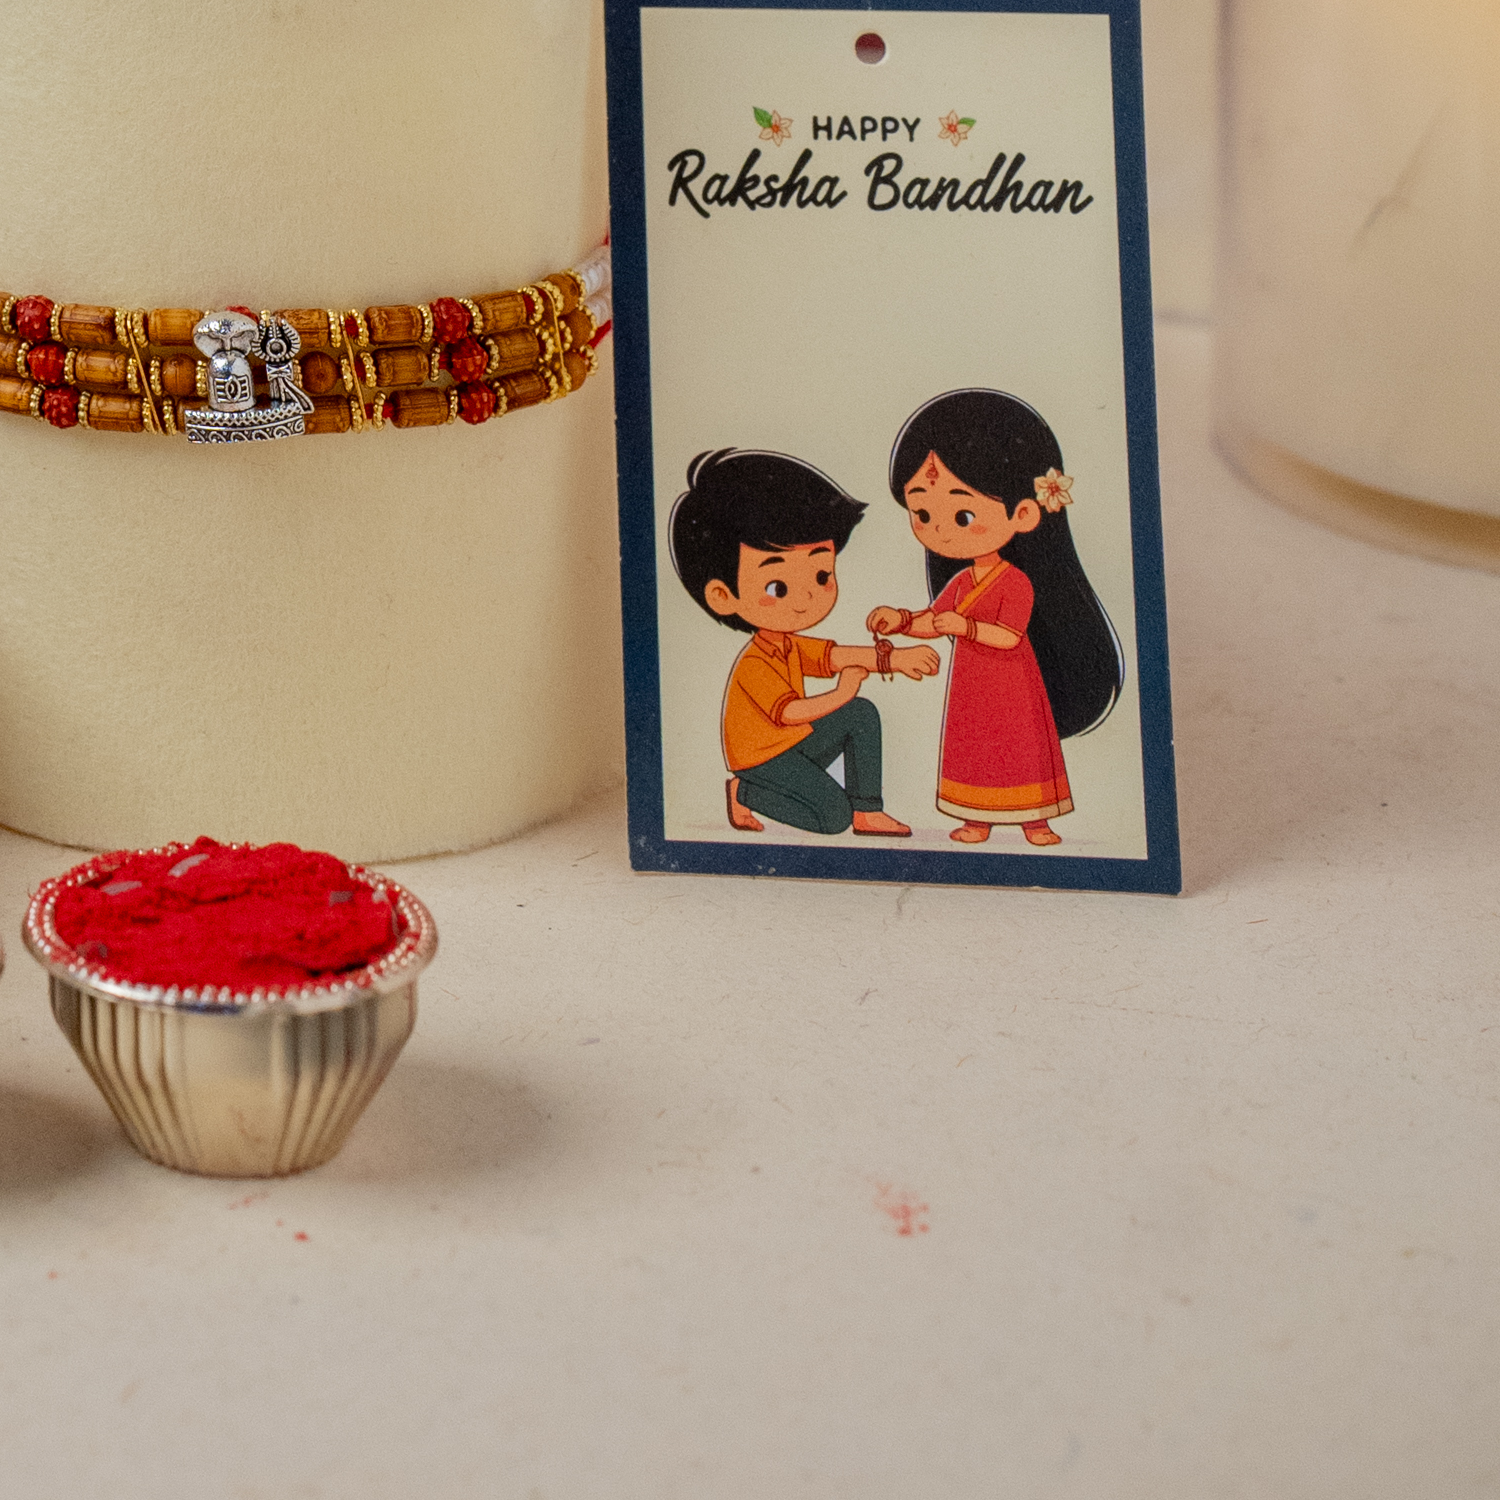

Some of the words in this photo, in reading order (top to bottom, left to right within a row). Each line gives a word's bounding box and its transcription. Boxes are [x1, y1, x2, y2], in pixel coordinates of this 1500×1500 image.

[811, 115, 921, 142] HAPPY
[666, 148, 848, 219] Raksha
[863, 151, 1094, 215] Bandhan
